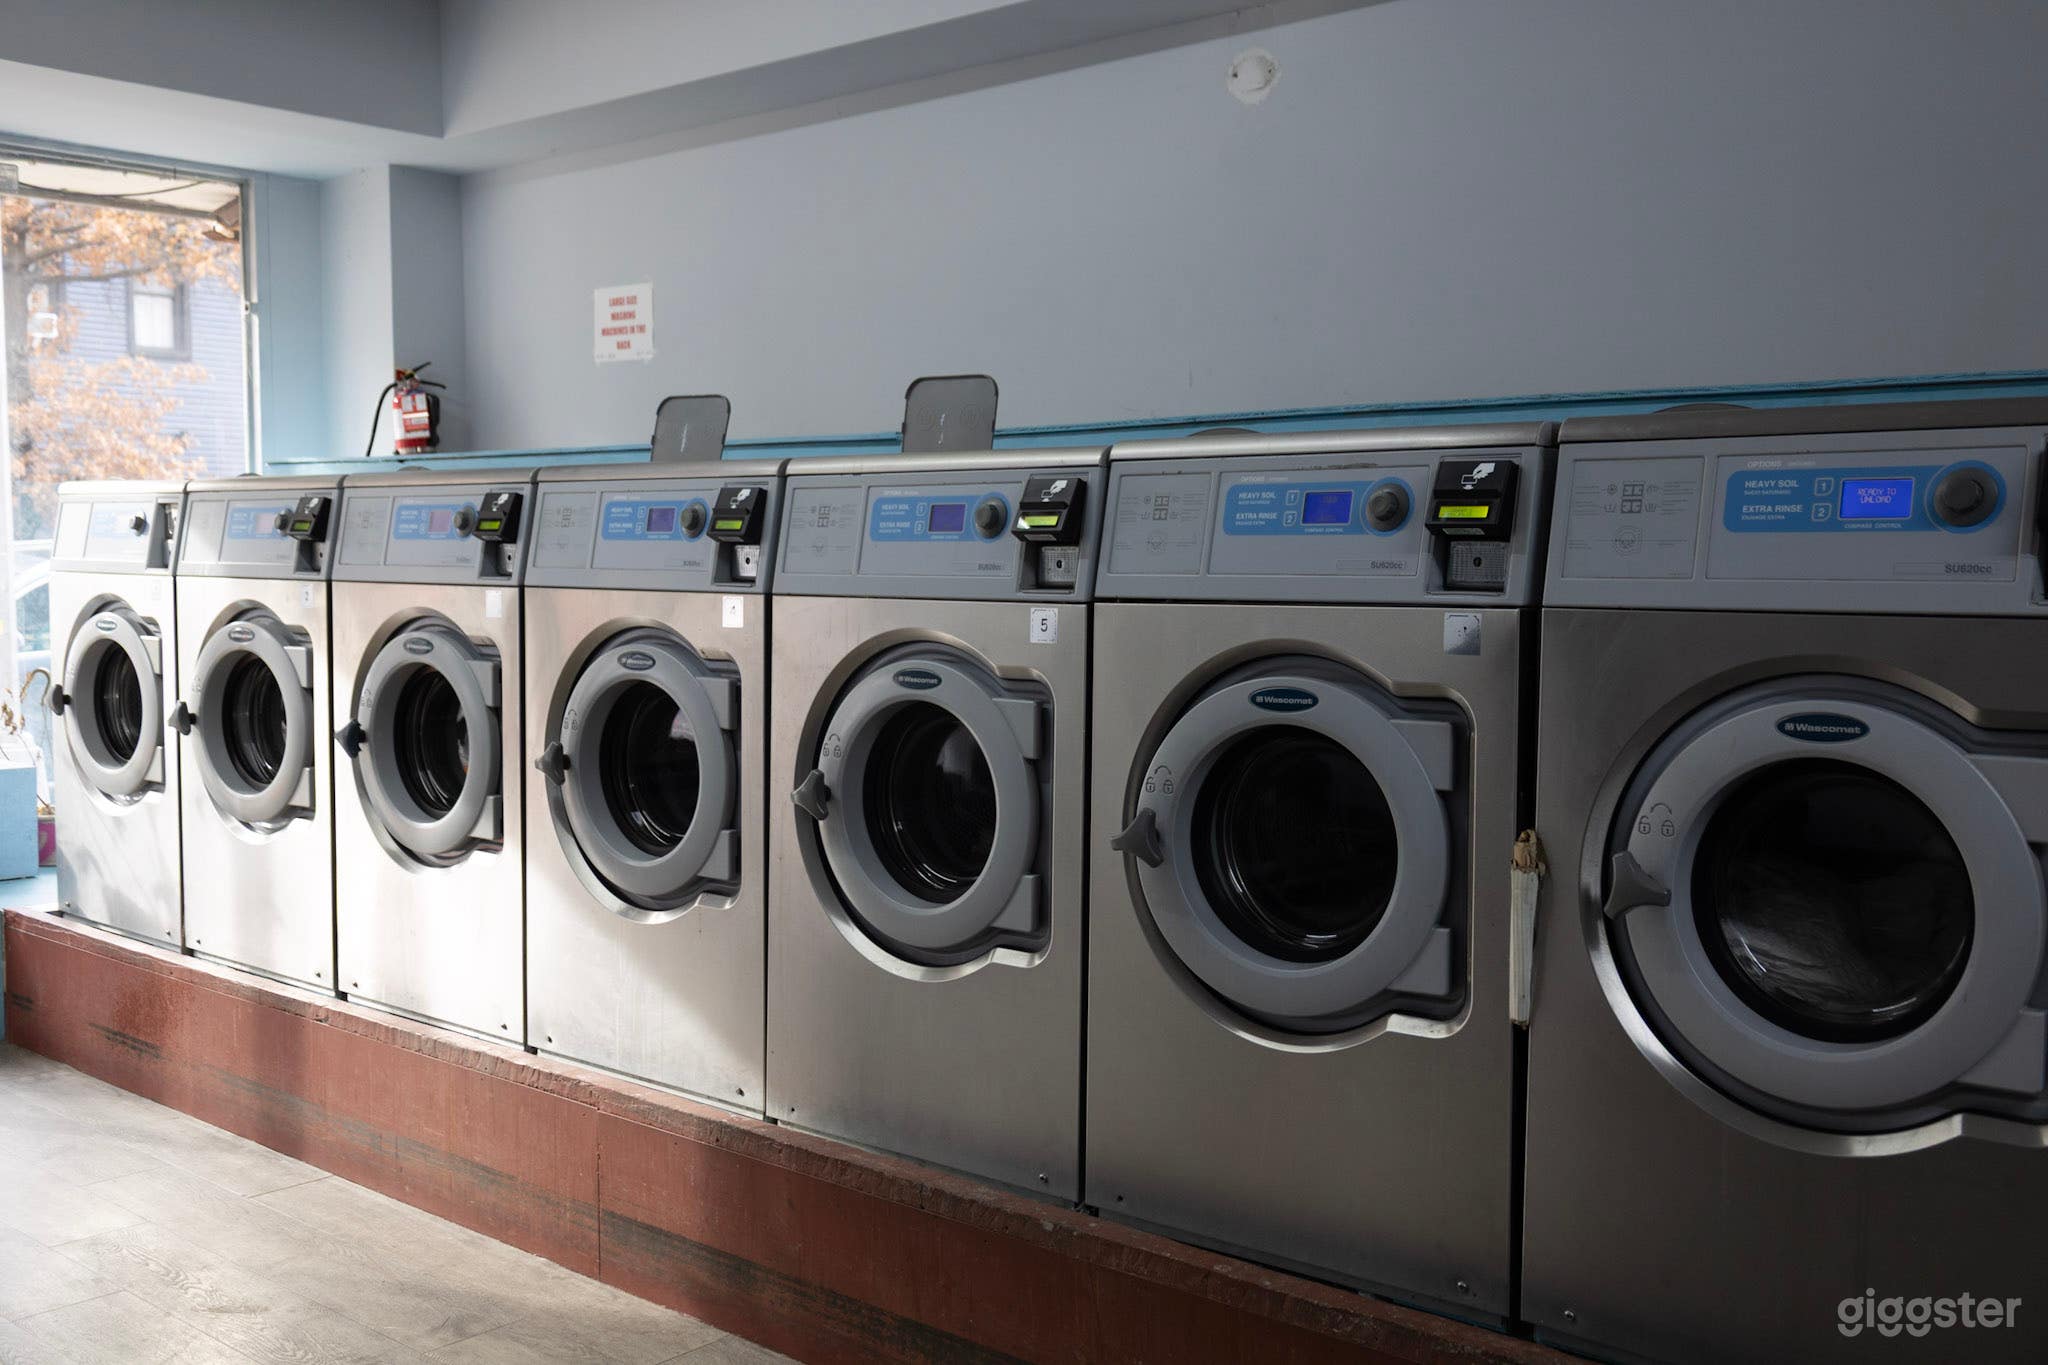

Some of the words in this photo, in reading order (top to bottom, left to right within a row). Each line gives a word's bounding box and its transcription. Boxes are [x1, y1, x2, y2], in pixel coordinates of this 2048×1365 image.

[1744, 480, 1776, 489] HEAVY
[1777, 479, 1800, 488] SOIL
[1262, 491, 1276, 499] SOIL
[1857, 487, 1885, 495] READY
[1887, 487, 1897, 495] TO
[1860, 496, 1891, 504] UNLOAD
[1742, 505, 1773, 513] EXTRA
[1775, 504, 1804, 513] RINSE
[1236, 512, 1257, 520] EXTRA
[1258, 512, 1278, 520] RINSE
[1040, 618, 1048, 633] 5
[1264, 696, 1313, 705] Wascomat
[1796, 722, 1861, 734] Wascomat
